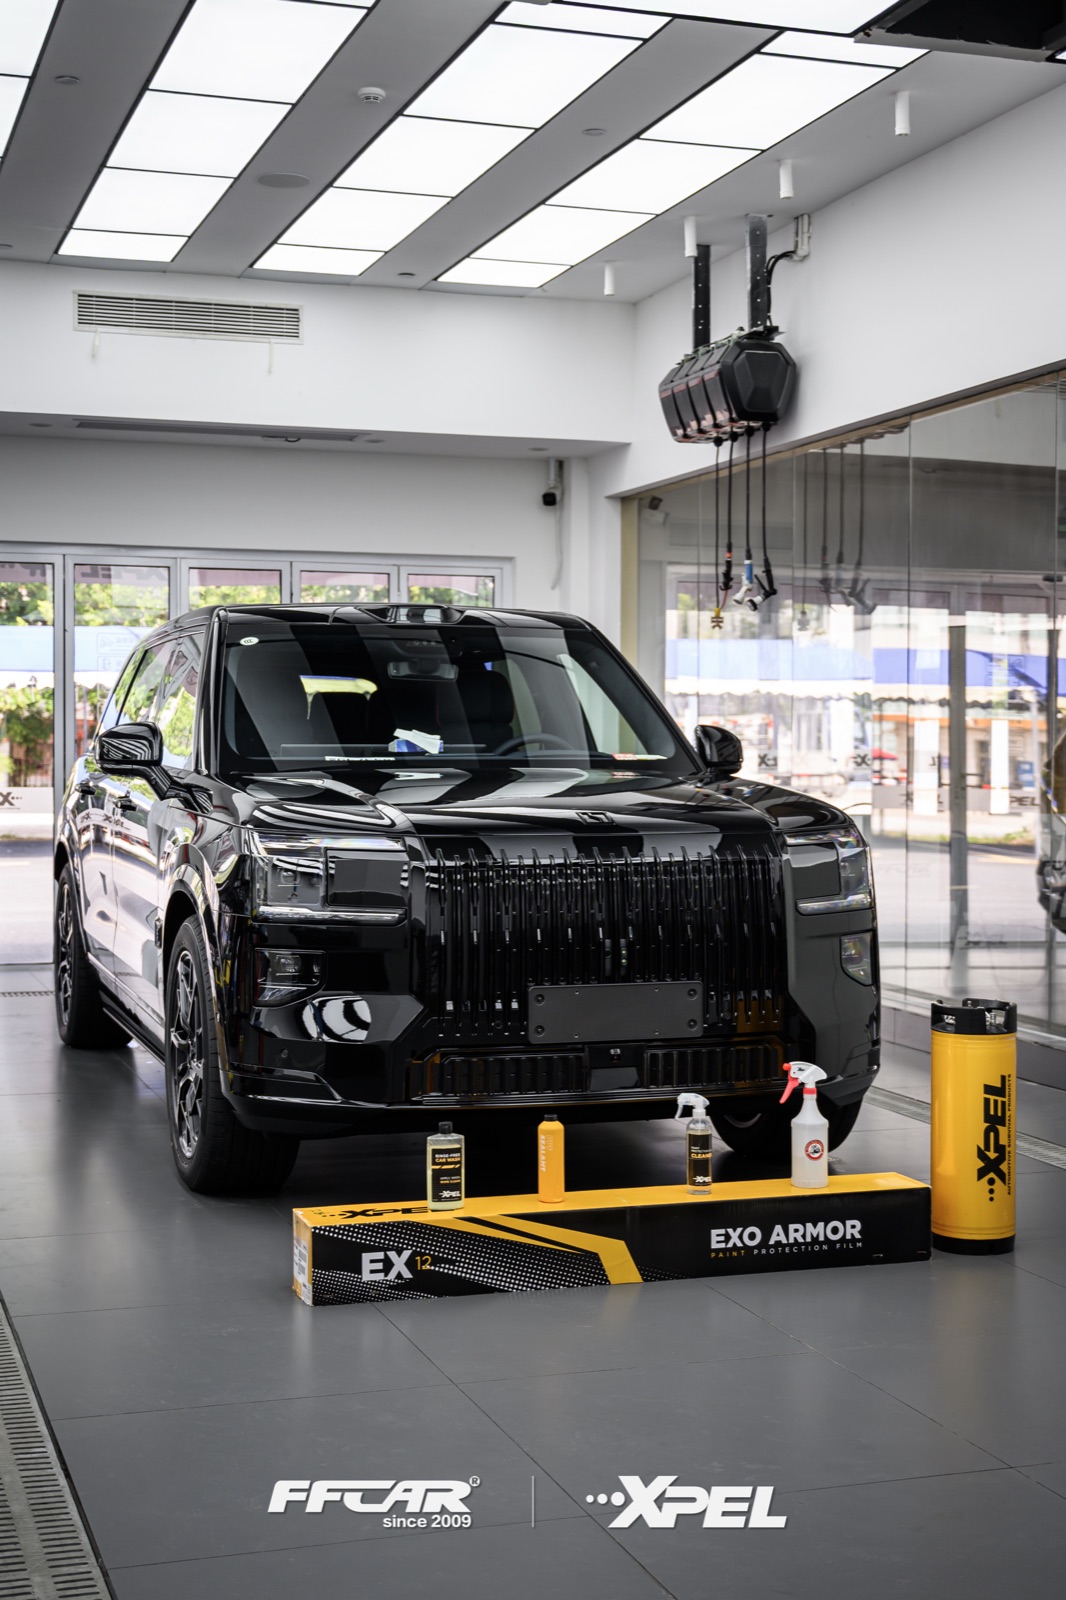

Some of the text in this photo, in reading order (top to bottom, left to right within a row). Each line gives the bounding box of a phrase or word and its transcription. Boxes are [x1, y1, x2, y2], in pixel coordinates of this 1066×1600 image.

[976, 1074, 1007, 1187] XPEL
[441, 1190, 461, 1198] XPEL
[340, 1206, 430, 1220] XPE
[710, 1219, 862, 1249] EXO ARMOR
[710, 1250, 745, 1258] PAINT
[753, 1244, 828, 1255] PROTECTION
[362, 1250, 432, 1280] EX 12
